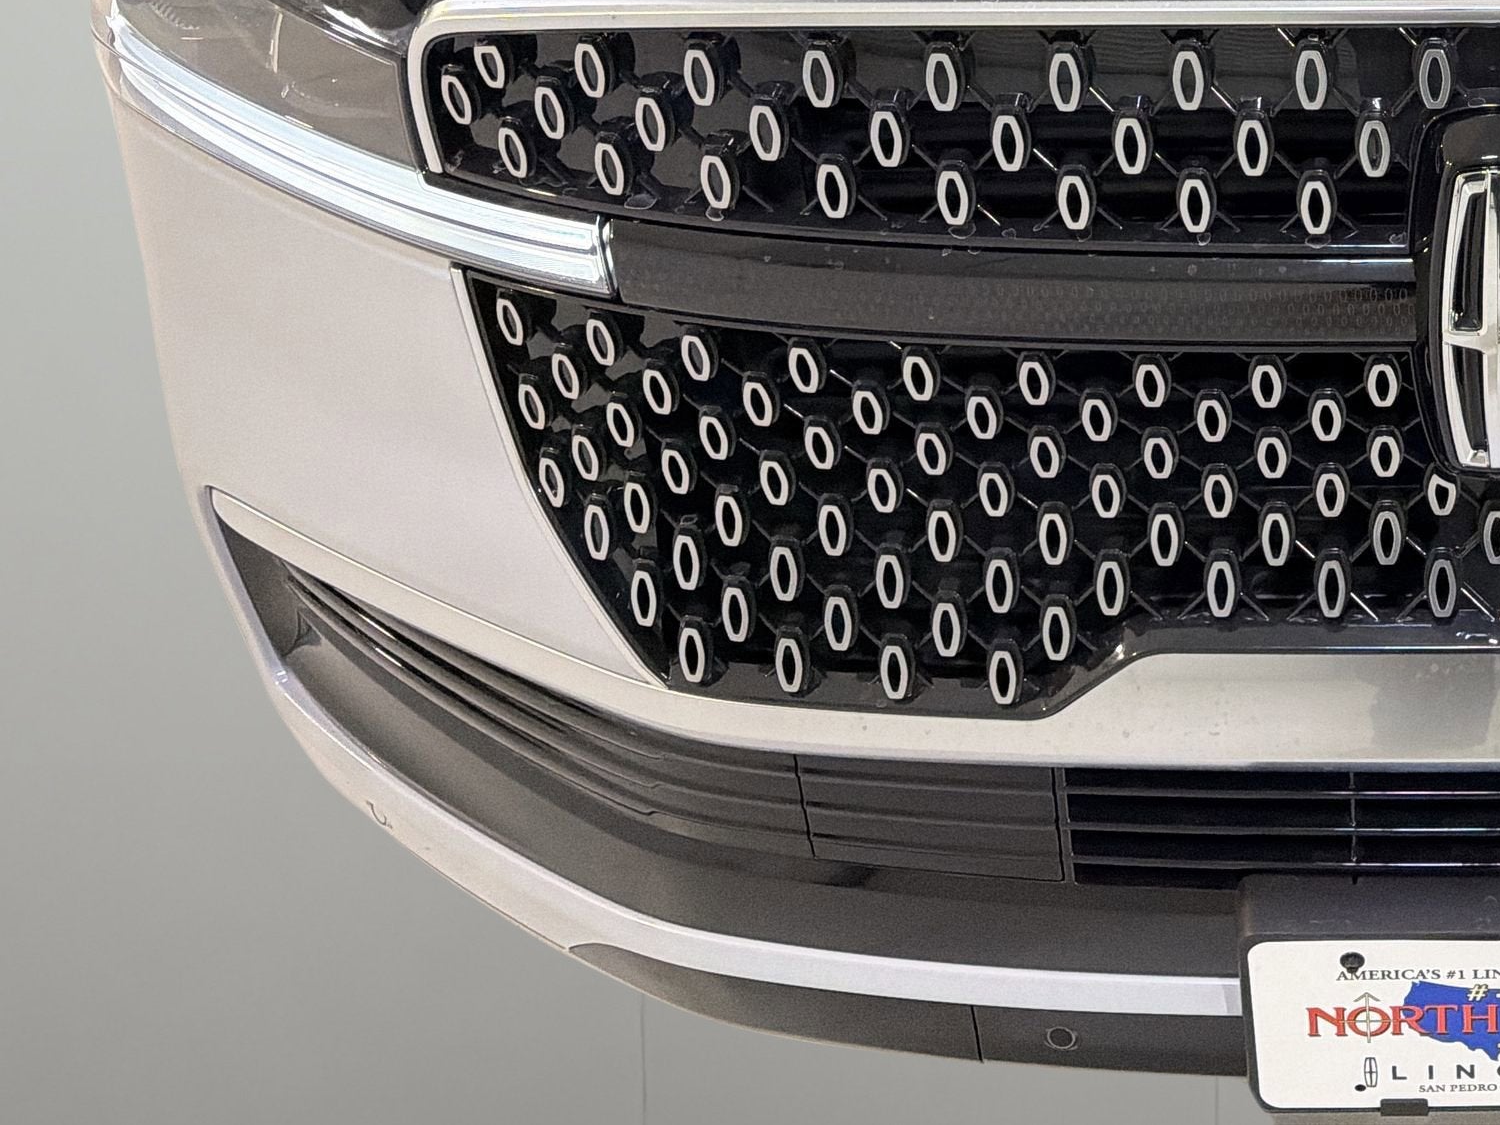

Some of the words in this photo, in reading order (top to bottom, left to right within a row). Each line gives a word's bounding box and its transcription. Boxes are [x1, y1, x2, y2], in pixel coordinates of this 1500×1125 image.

[1336, 969, 1441, 981] AMERICA'S
[1446, 969, 1466, 980] #1
[1306, 1003, 1498, 1037] NORTH
[1418, 1084, 1446, 1093] SAN
[1450, 1083, 1497, 1092] PEDRO
